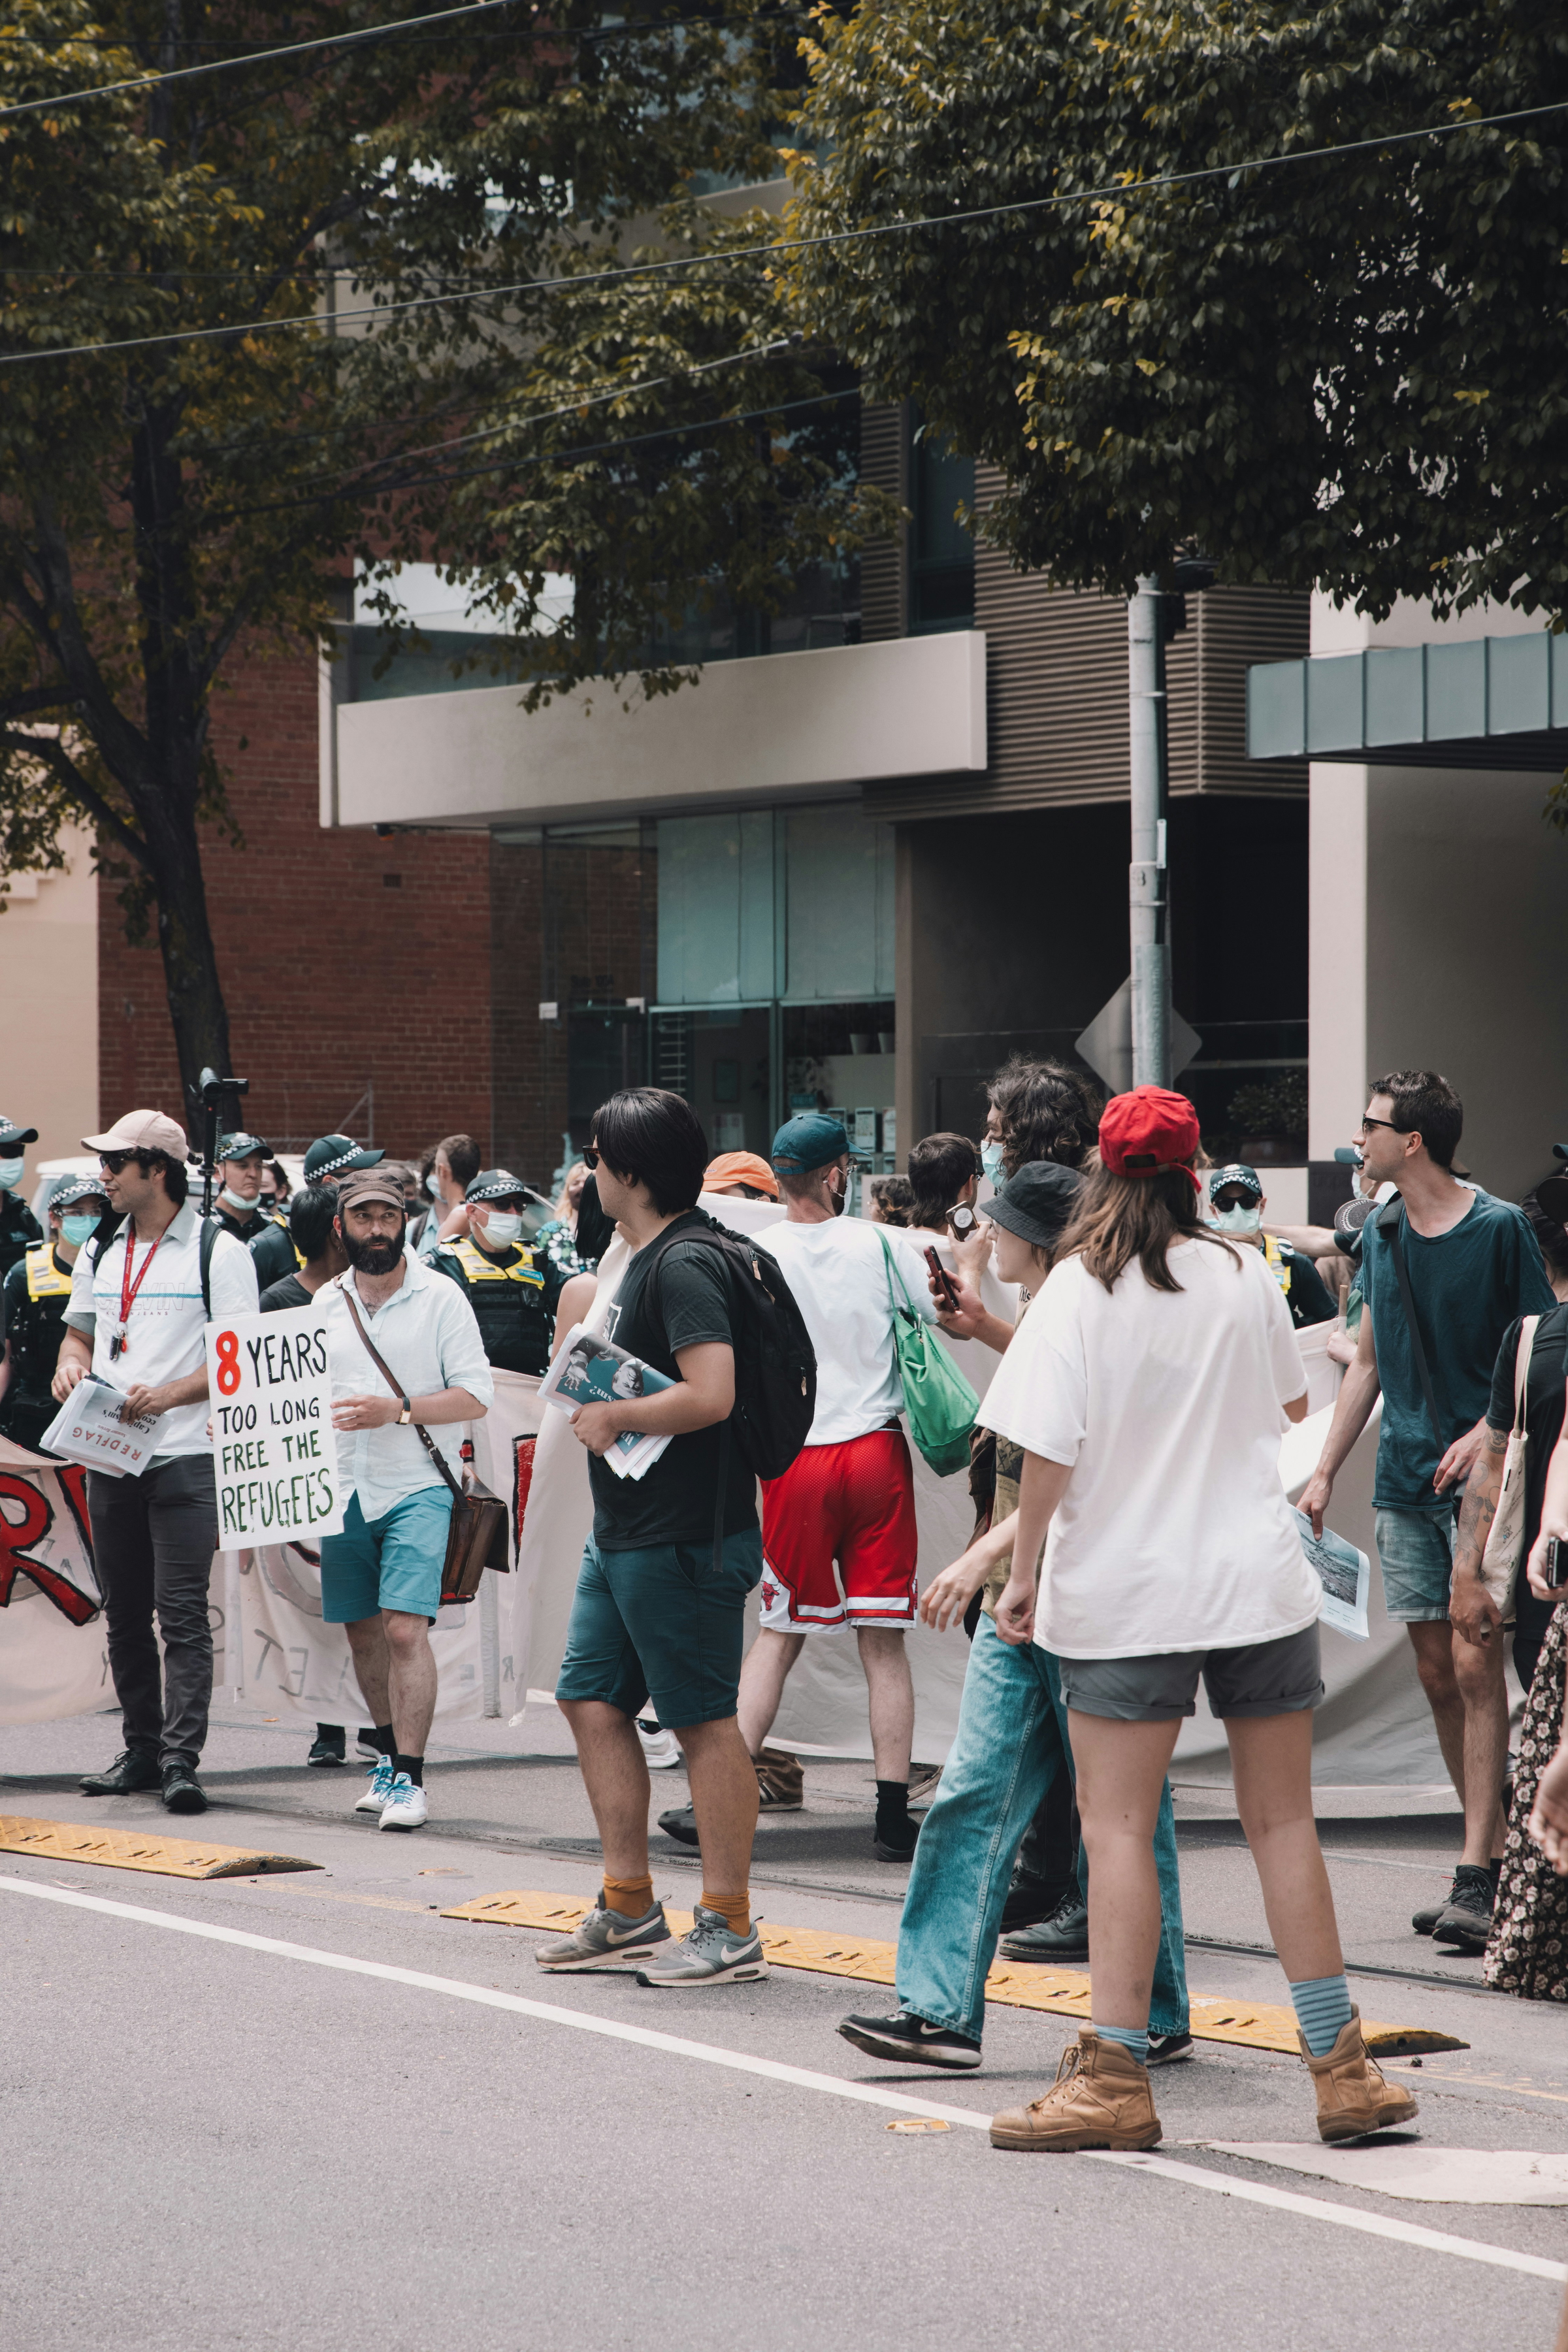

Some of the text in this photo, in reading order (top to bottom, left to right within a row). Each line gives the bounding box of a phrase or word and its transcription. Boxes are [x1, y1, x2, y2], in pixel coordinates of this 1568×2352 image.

[518, 1269, 540, 1279] Police
[216, 1328, 327, 1396] 8 YEARS
[218, 1397, 319, 1435] TOO LONG
[222, 1429, 321, 1475] FREE THE
[221, 1467, 333, 1534] REFUGEES
